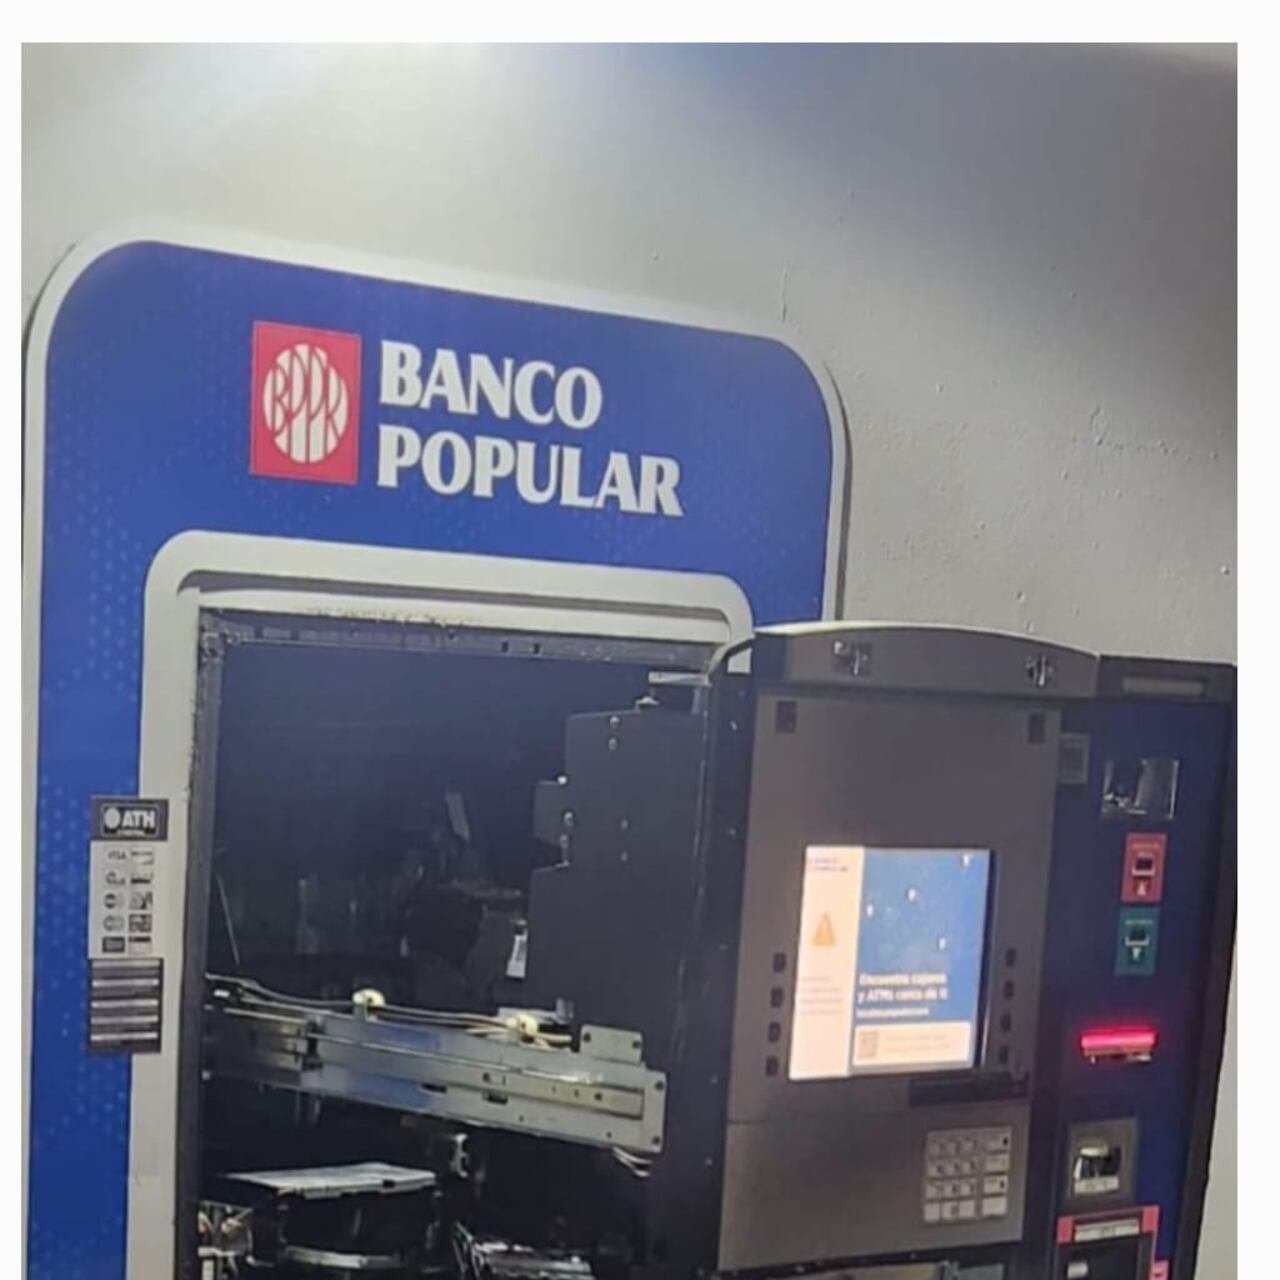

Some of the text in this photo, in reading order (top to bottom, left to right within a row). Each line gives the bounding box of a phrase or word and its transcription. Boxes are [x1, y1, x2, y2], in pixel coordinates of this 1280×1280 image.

[263, 342, 349, 464] BPPR
[379, 340, 603, 429] BANCO
[377, 423, 684, 516] POPULAR
[122, 809, 156, 828] ATH
